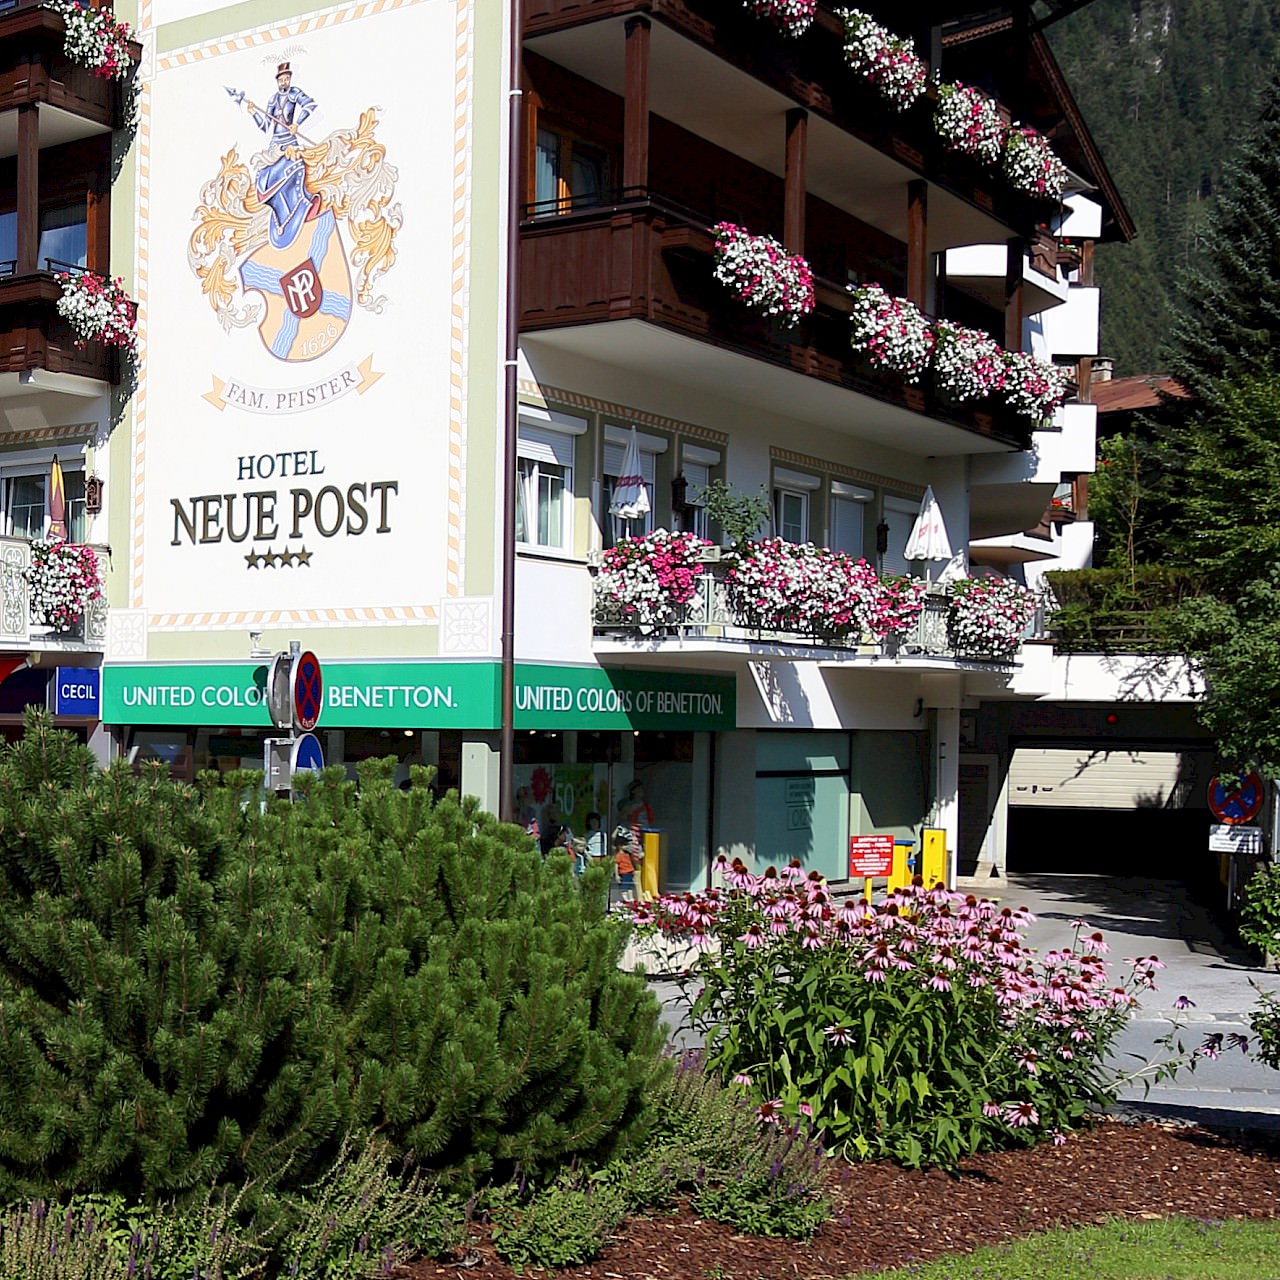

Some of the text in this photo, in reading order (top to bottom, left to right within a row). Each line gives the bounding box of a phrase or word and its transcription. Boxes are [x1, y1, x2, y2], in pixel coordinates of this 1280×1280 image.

[301, 324, 338, 356] 1626
[227, 370, 356, 409] FAM. PFISTER
[236, 450, 326, 480] HOTEL
[170, 480, 399, 546] NEUE POST
[61, 684, 96, 700] CECIL
[123, 686, 195, 707] UNITED
[328, 686, 458, 708] BENETTON.
[515, 685, 724, 715] UNITED COLORS OF BENETTON.
